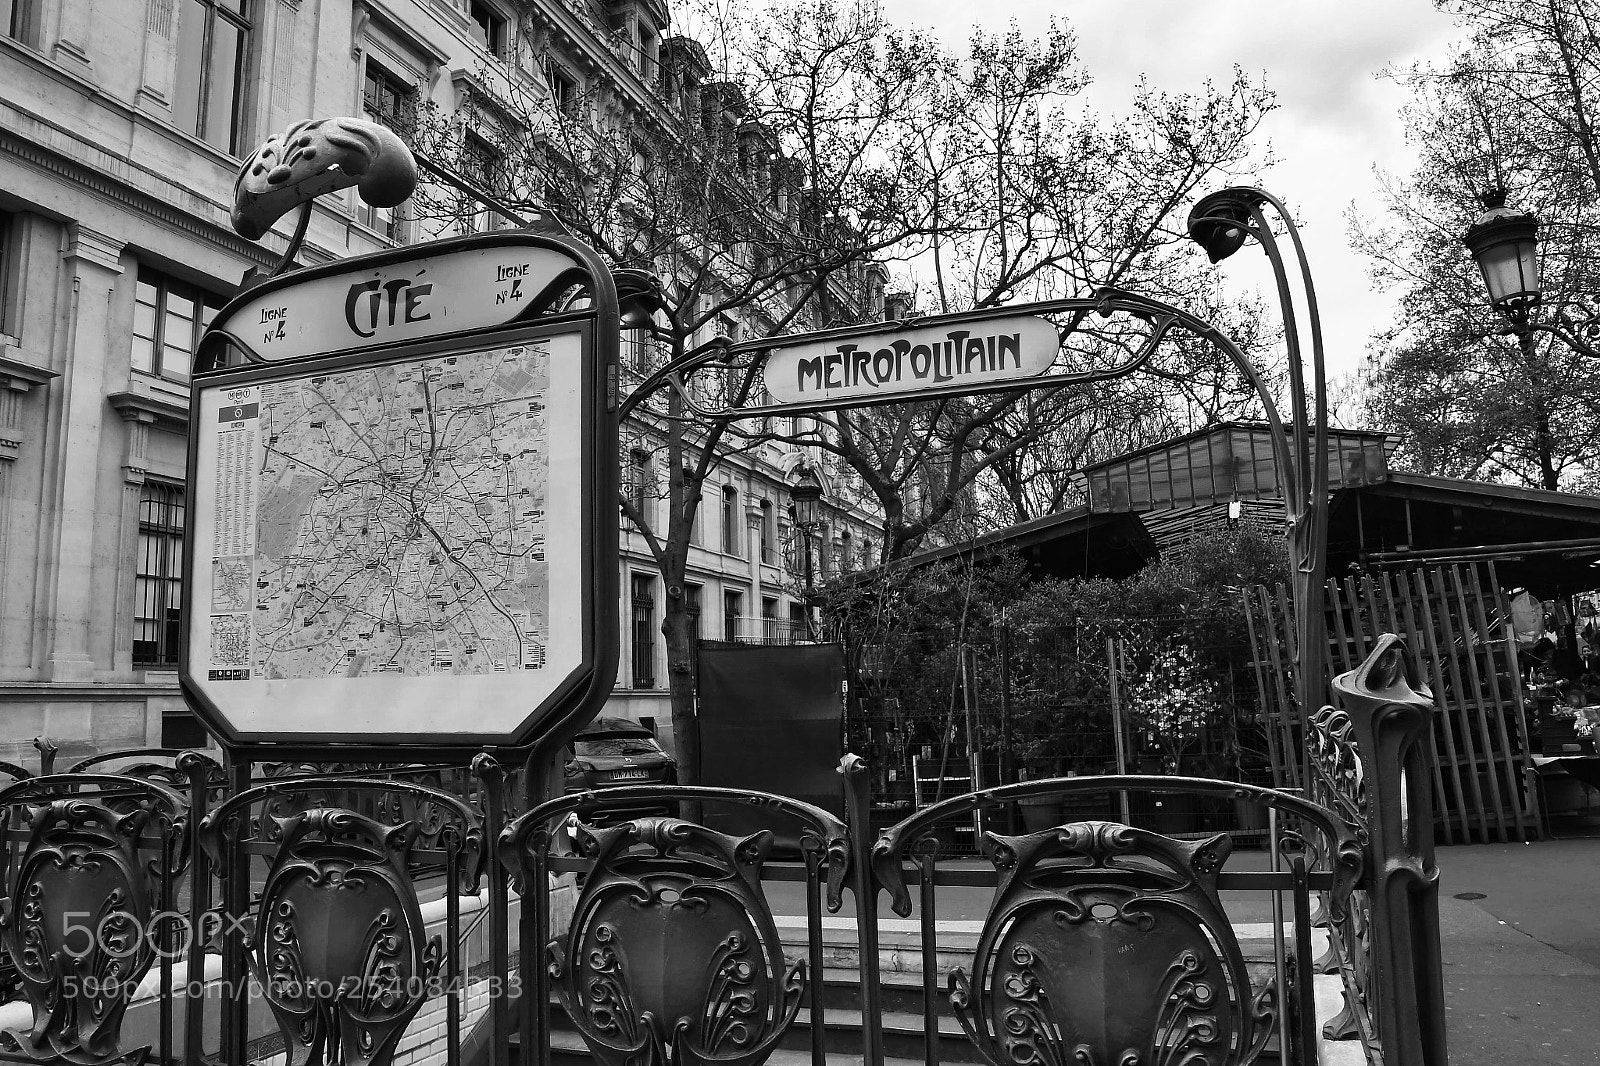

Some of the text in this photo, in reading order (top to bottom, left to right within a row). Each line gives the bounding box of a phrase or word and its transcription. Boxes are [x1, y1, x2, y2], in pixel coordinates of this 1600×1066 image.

[495, 263, 530, 283] LIGNE
[258, 306, 288, 325] LIGNE
[345, 269, 433, 338] CITÉ
[797, 330, 1022, 392] METROPOLITAIN
